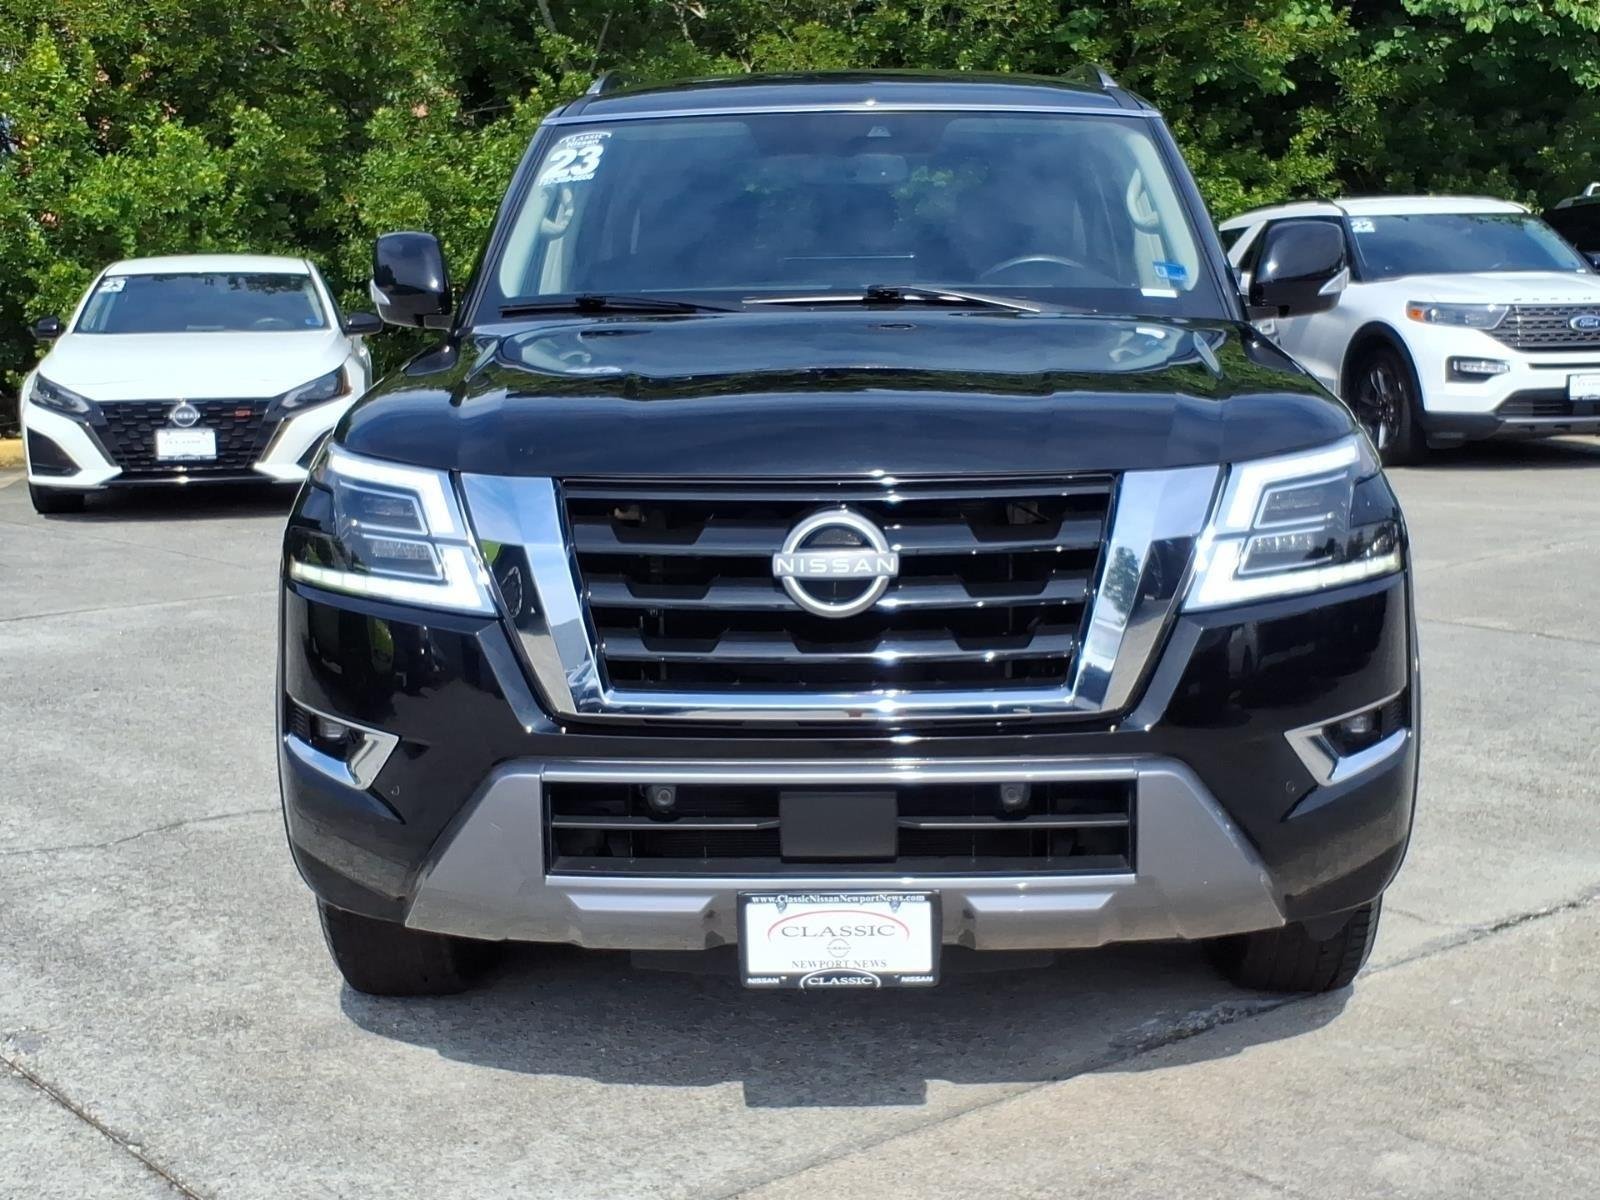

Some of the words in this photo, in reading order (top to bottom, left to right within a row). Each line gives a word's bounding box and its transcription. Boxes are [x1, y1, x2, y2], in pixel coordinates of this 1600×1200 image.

[539, 145, 604, 181] 23
[776, 558, 895, 573] NISSAN
[751, 894, 926, 905] www.ClassicNissanNewportNews.com
[781, 924, 896, 938] CLASSIC
[791, 959, 850, 969] NEWPORT
[853, 959, 888, 969] NEWS
[807, 976, 873, 985] CLASSIC
